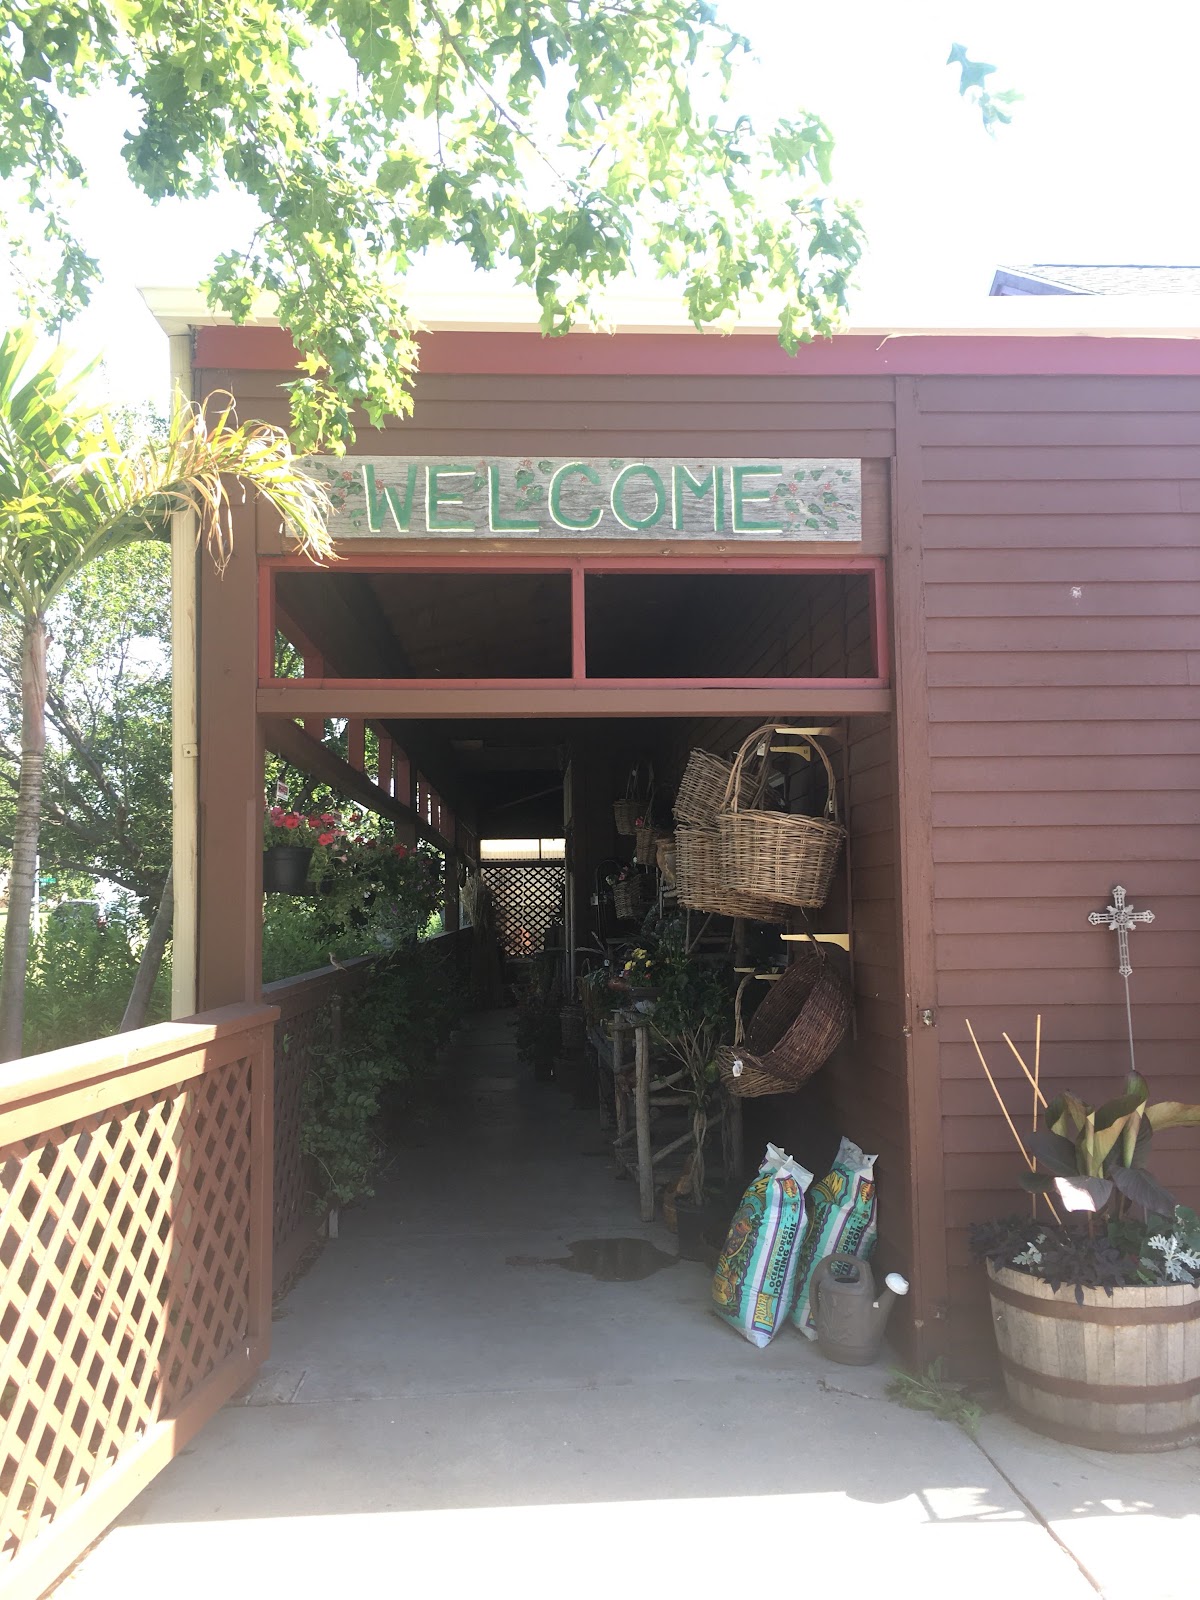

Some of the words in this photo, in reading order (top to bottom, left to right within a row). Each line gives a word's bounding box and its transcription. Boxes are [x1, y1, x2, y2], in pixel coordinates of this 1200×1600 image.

[361, 462, 783, 535] WELCOME
[769, 1259, 781, 1288] OCEAN
[777, 1225, 790, 1257] FOREST
[774, 1249, 790, 1294] POTTING
[786, 1222, 797, 1245] SOIL
[842, 1226, 855, 1252] OREST
[850, 1225, 863, 1246] SOIL
